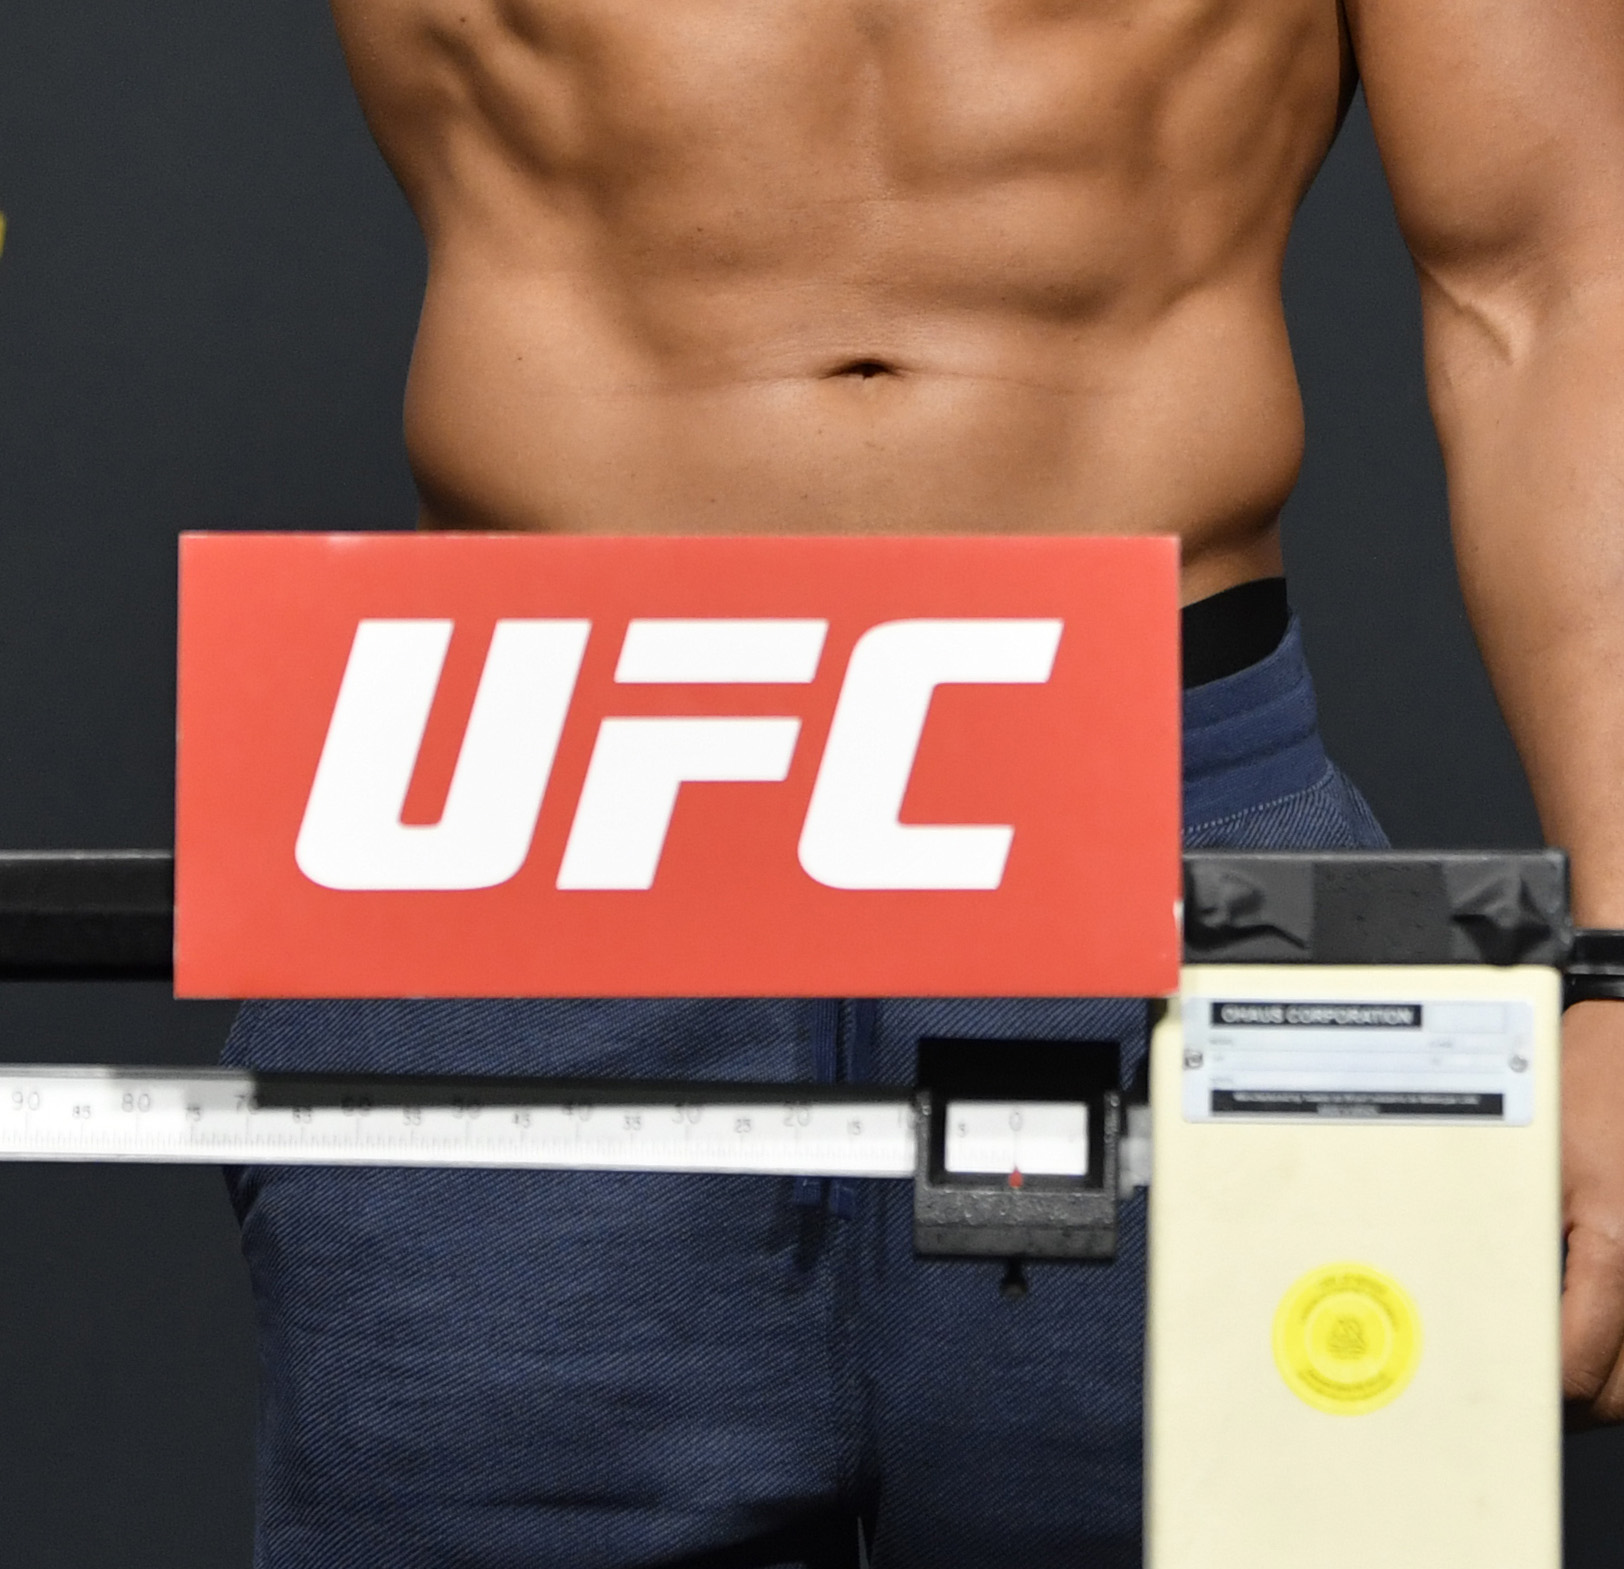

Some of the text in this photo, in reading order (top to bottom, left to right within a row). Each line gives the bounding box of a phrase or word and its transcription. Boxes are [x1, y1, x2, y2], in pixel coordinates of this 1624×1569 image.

[294, 618, 1063, 890] UFC
[1286, 1004, 1414, 1025] CORPORATION
[11, 1090, 41, 1112] 90
[121, 1092, 151, 1113] 80
[783, 1104, 813, 1127] 20
